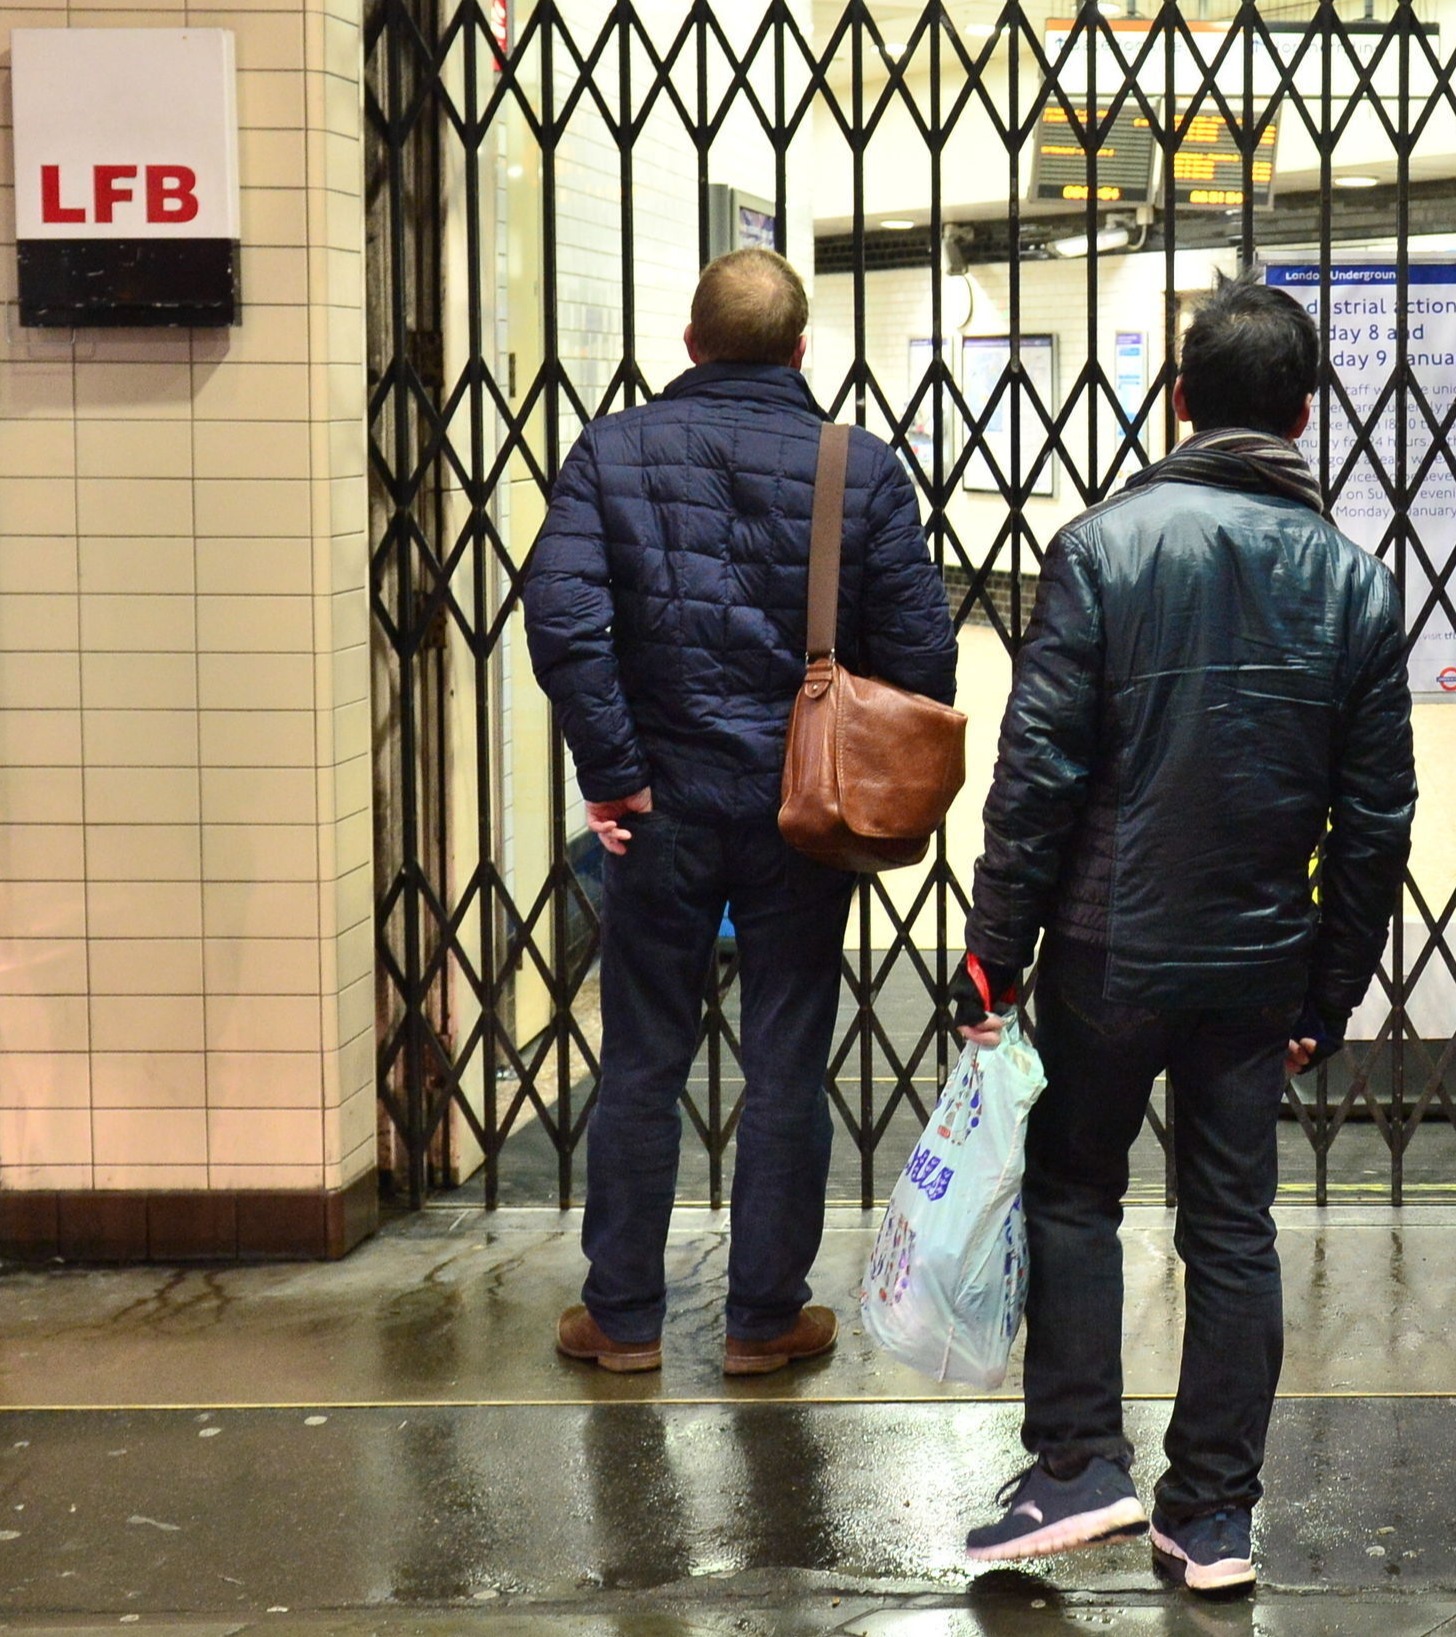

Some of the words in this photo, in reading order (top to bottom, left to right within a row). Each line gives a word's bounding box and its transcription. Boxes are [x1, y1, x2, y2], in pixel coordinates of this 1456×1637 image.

[41, 164, 200, 224] LFB
[1285, 271, 1320, 280] Londo
[1329, 270, 1397, 282] Undergroun
[1369, 325, 1378, 340] 8
[1387, 324, 1424, 340] ad
[1376, 351, 1387, 366] 9
